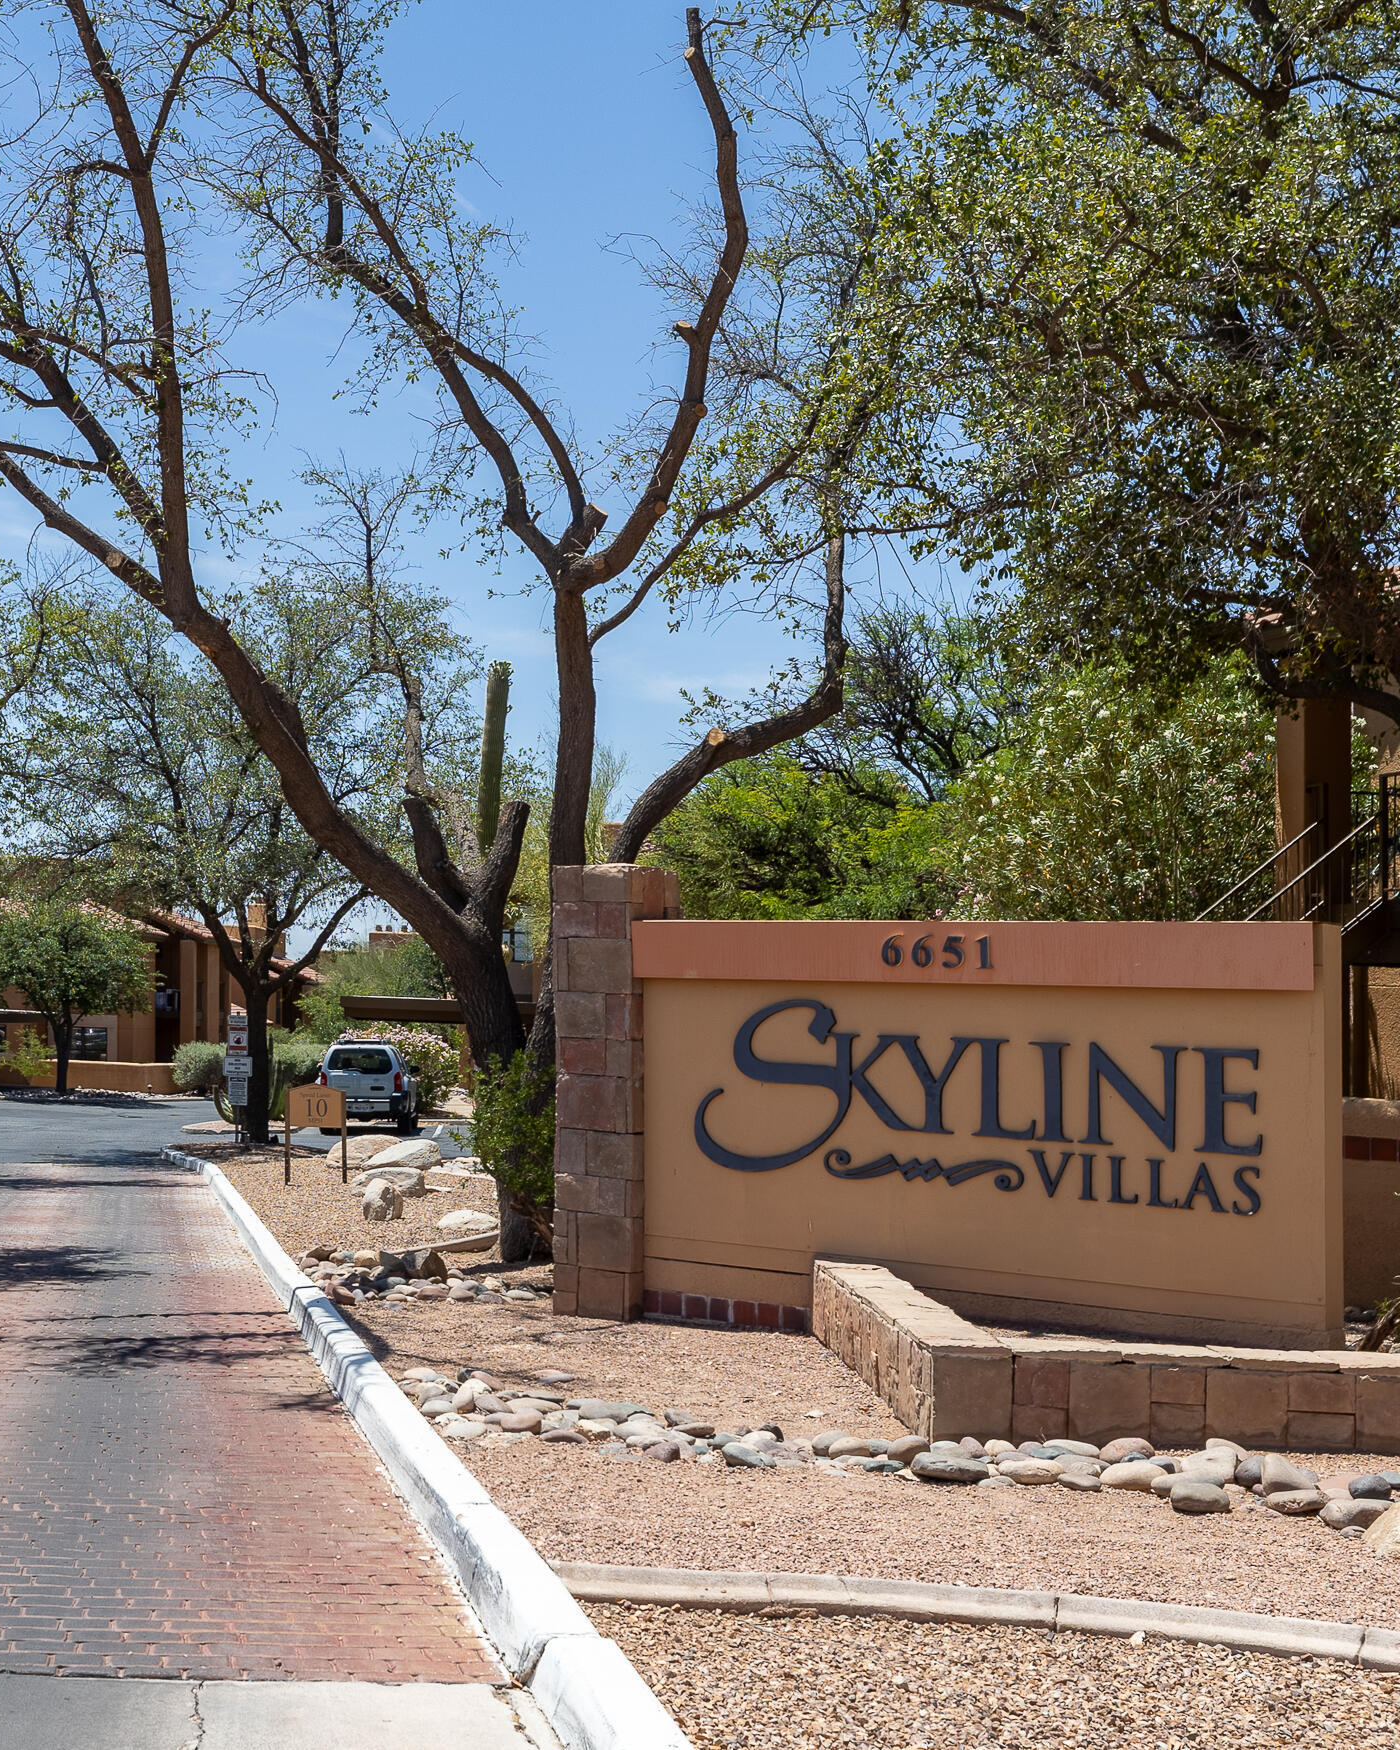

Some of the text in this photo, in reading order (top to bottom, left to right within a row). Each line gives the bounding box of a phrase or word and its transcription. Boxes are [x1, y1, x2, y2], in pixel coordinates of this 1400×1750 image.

[881, 933, 994, 970] 6651
[306, 1098, 328, 1118] 10
[694, 998, 1263, 1173] SKYLINE
[1027, 1149, 1261, 1217] VILLAS
